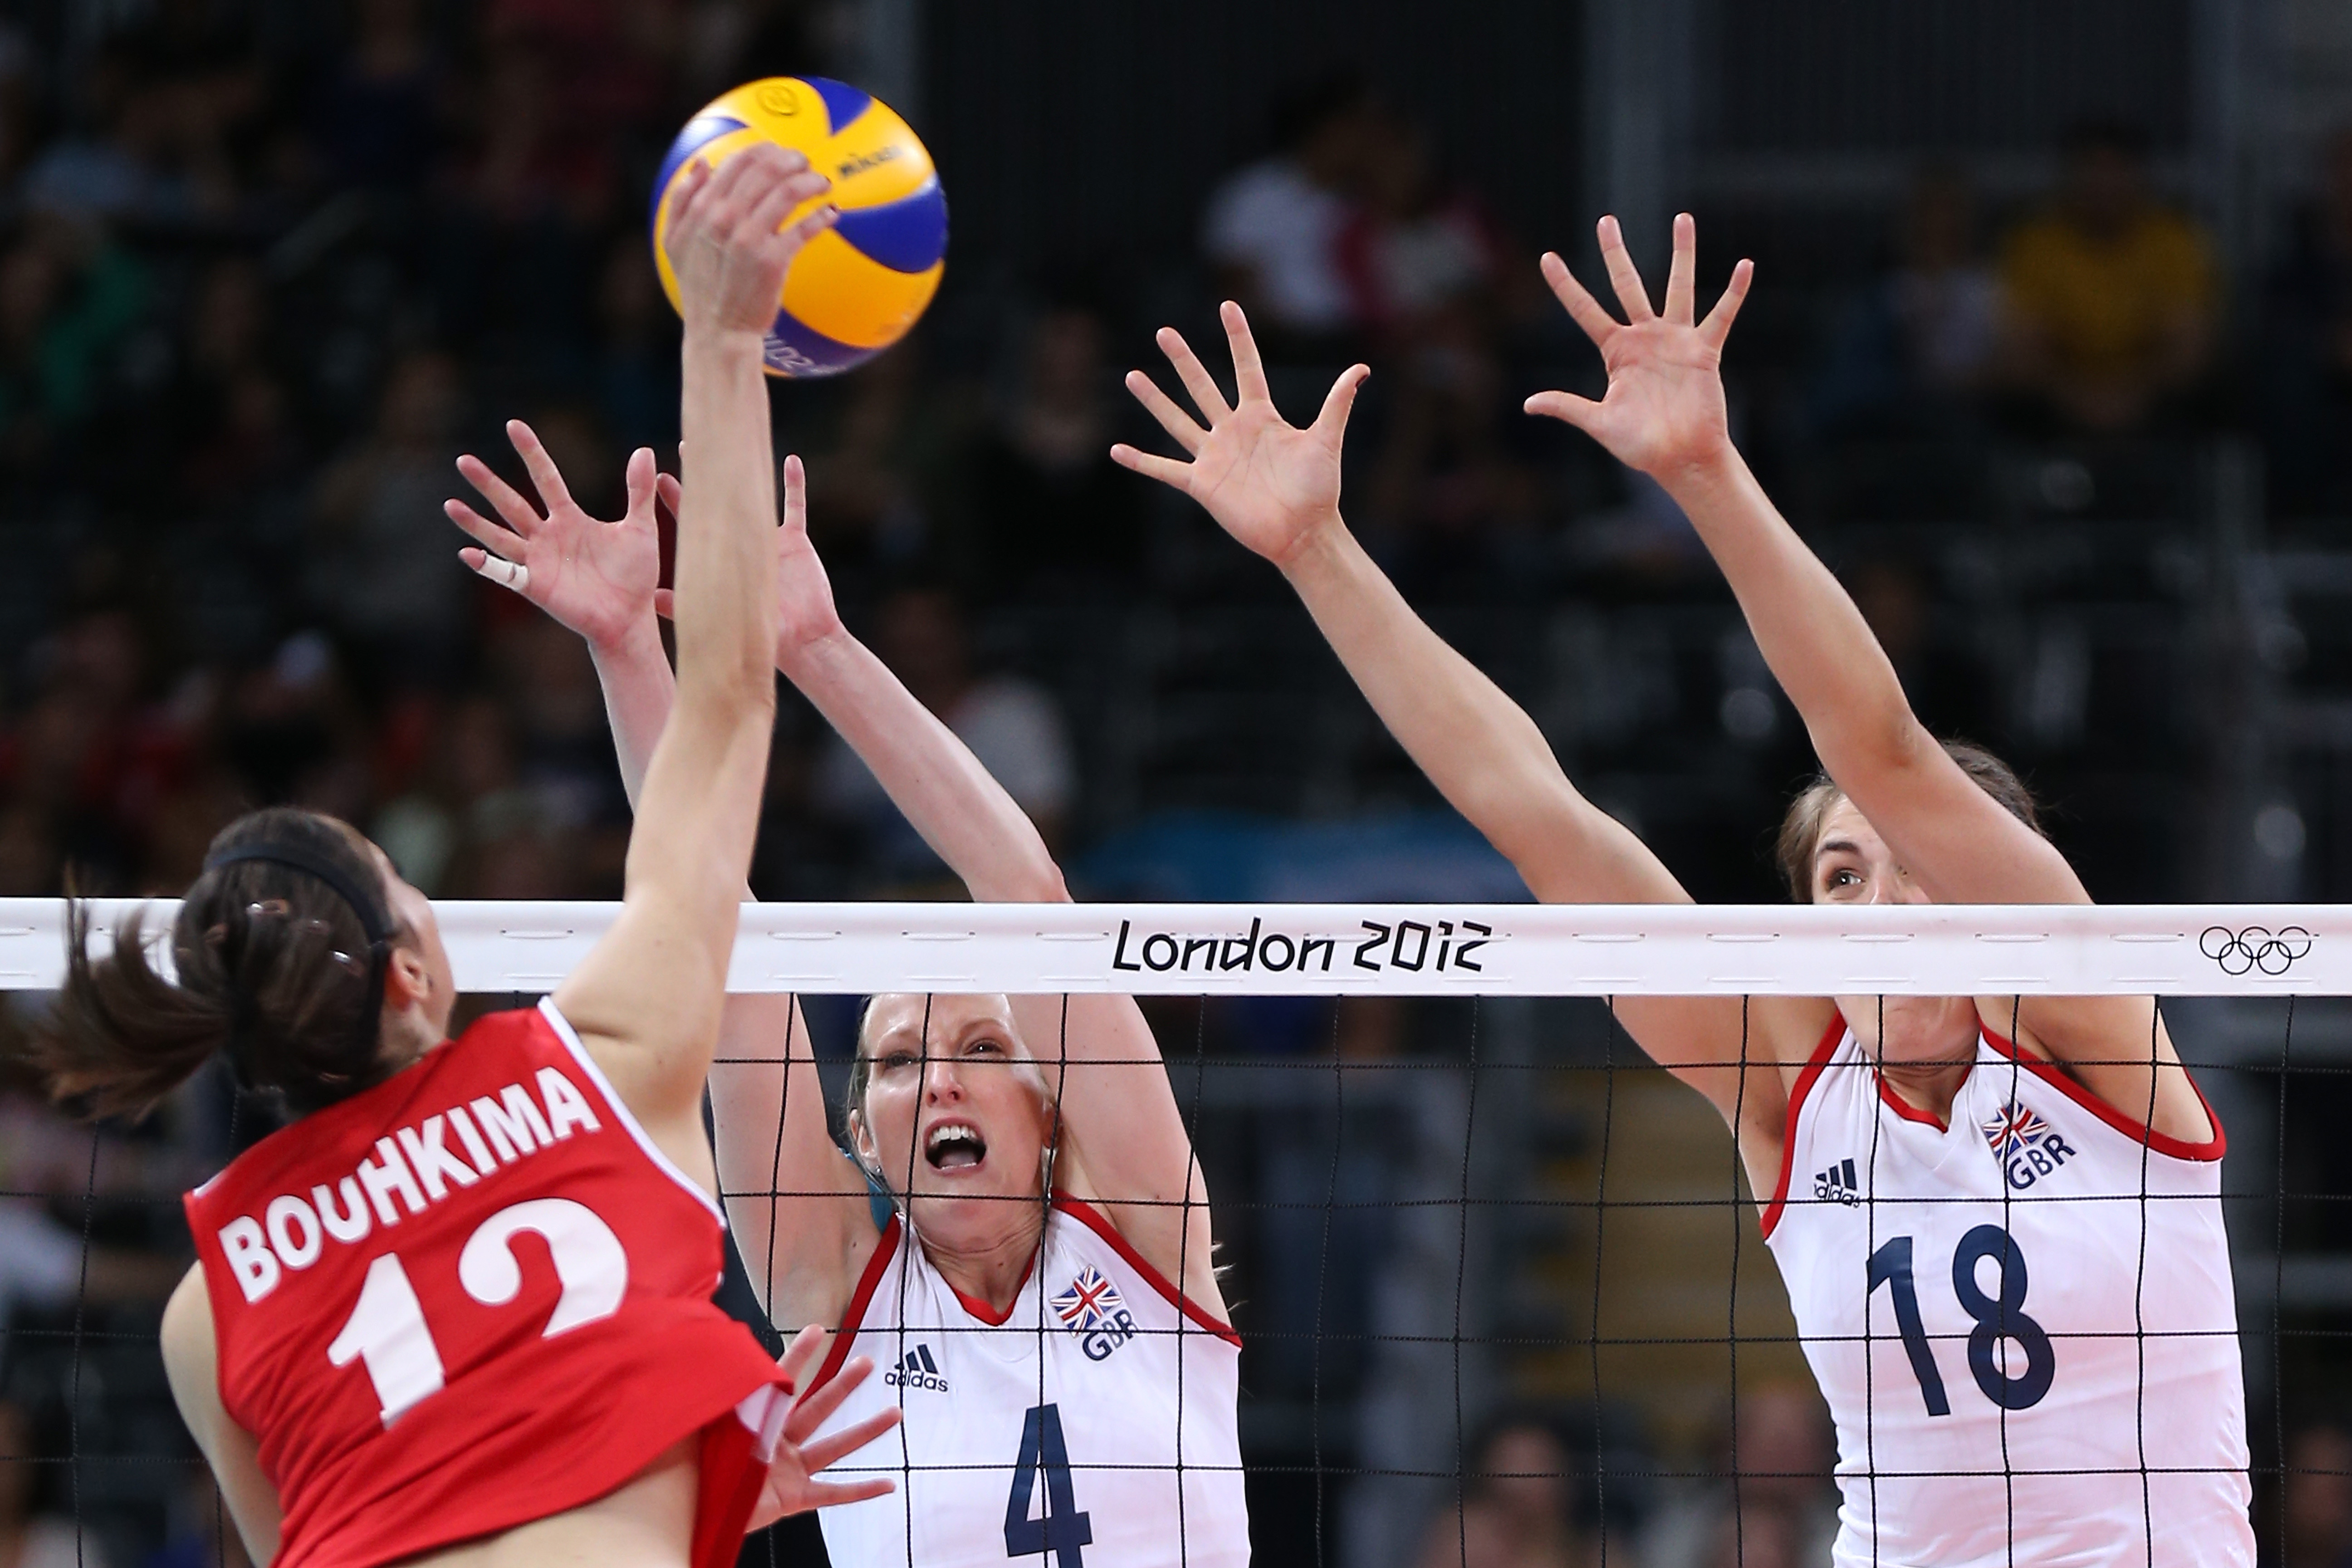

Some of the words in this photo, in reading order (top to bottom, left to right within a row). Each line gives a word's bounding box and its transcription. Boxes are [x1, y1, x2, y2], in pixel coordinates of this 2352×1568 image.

[1113, 916, 1334, 971] London
[1353, 920, 1491, 972] 2012
[217, 1066, 602, 1303] BOUHKIMA
[2009, 1135, 2077, 1189] GBR
[327, 1197, 628, 1431] 12
[1082, 1309, 1139, 1361] GBR
[1867, 1224, 2055, 1416] 18
[885, 1370, 948, 1392] adidas
[1004, 1403, 1093, 1568] 4
